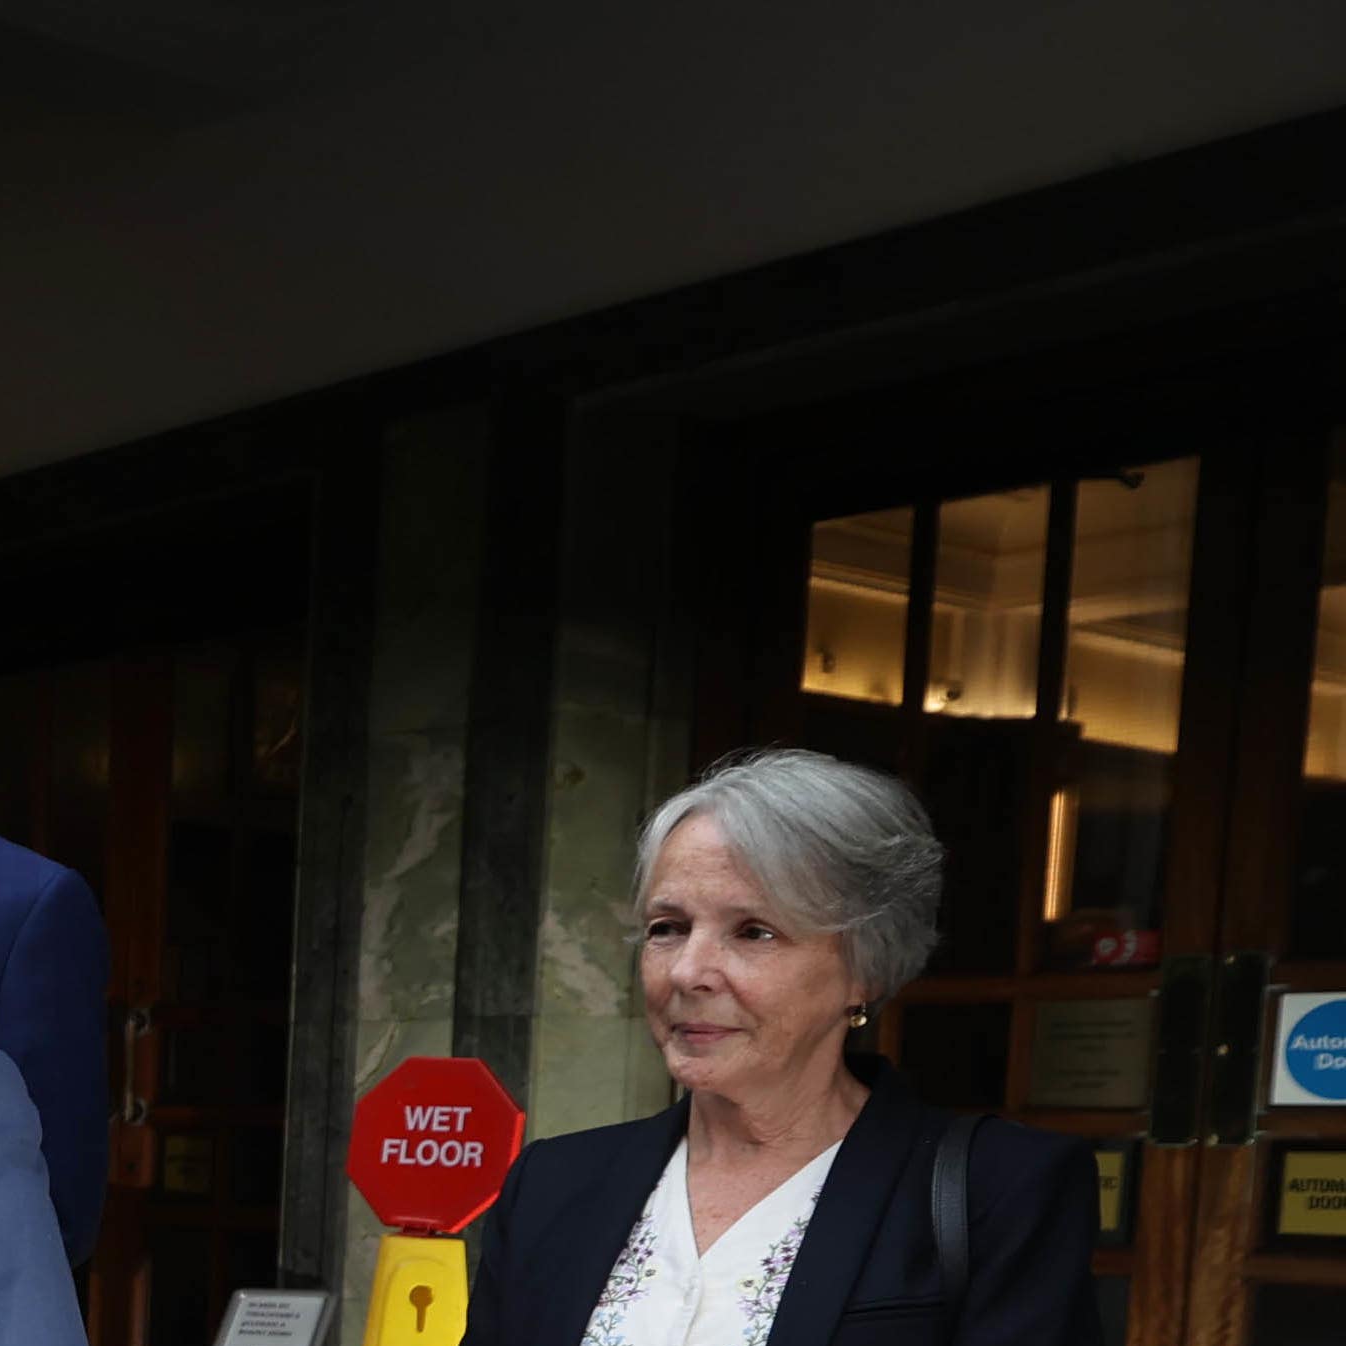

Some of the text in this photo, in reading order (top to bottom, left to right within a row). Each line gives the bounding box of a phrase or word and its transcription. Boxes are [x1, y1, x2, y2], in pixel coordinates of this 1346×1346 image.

[1290, 1034, 1346, 1049] Auto
[405, 1105, 472, 1132] WET
[380, 1138, 484, 1168] FLOOR
